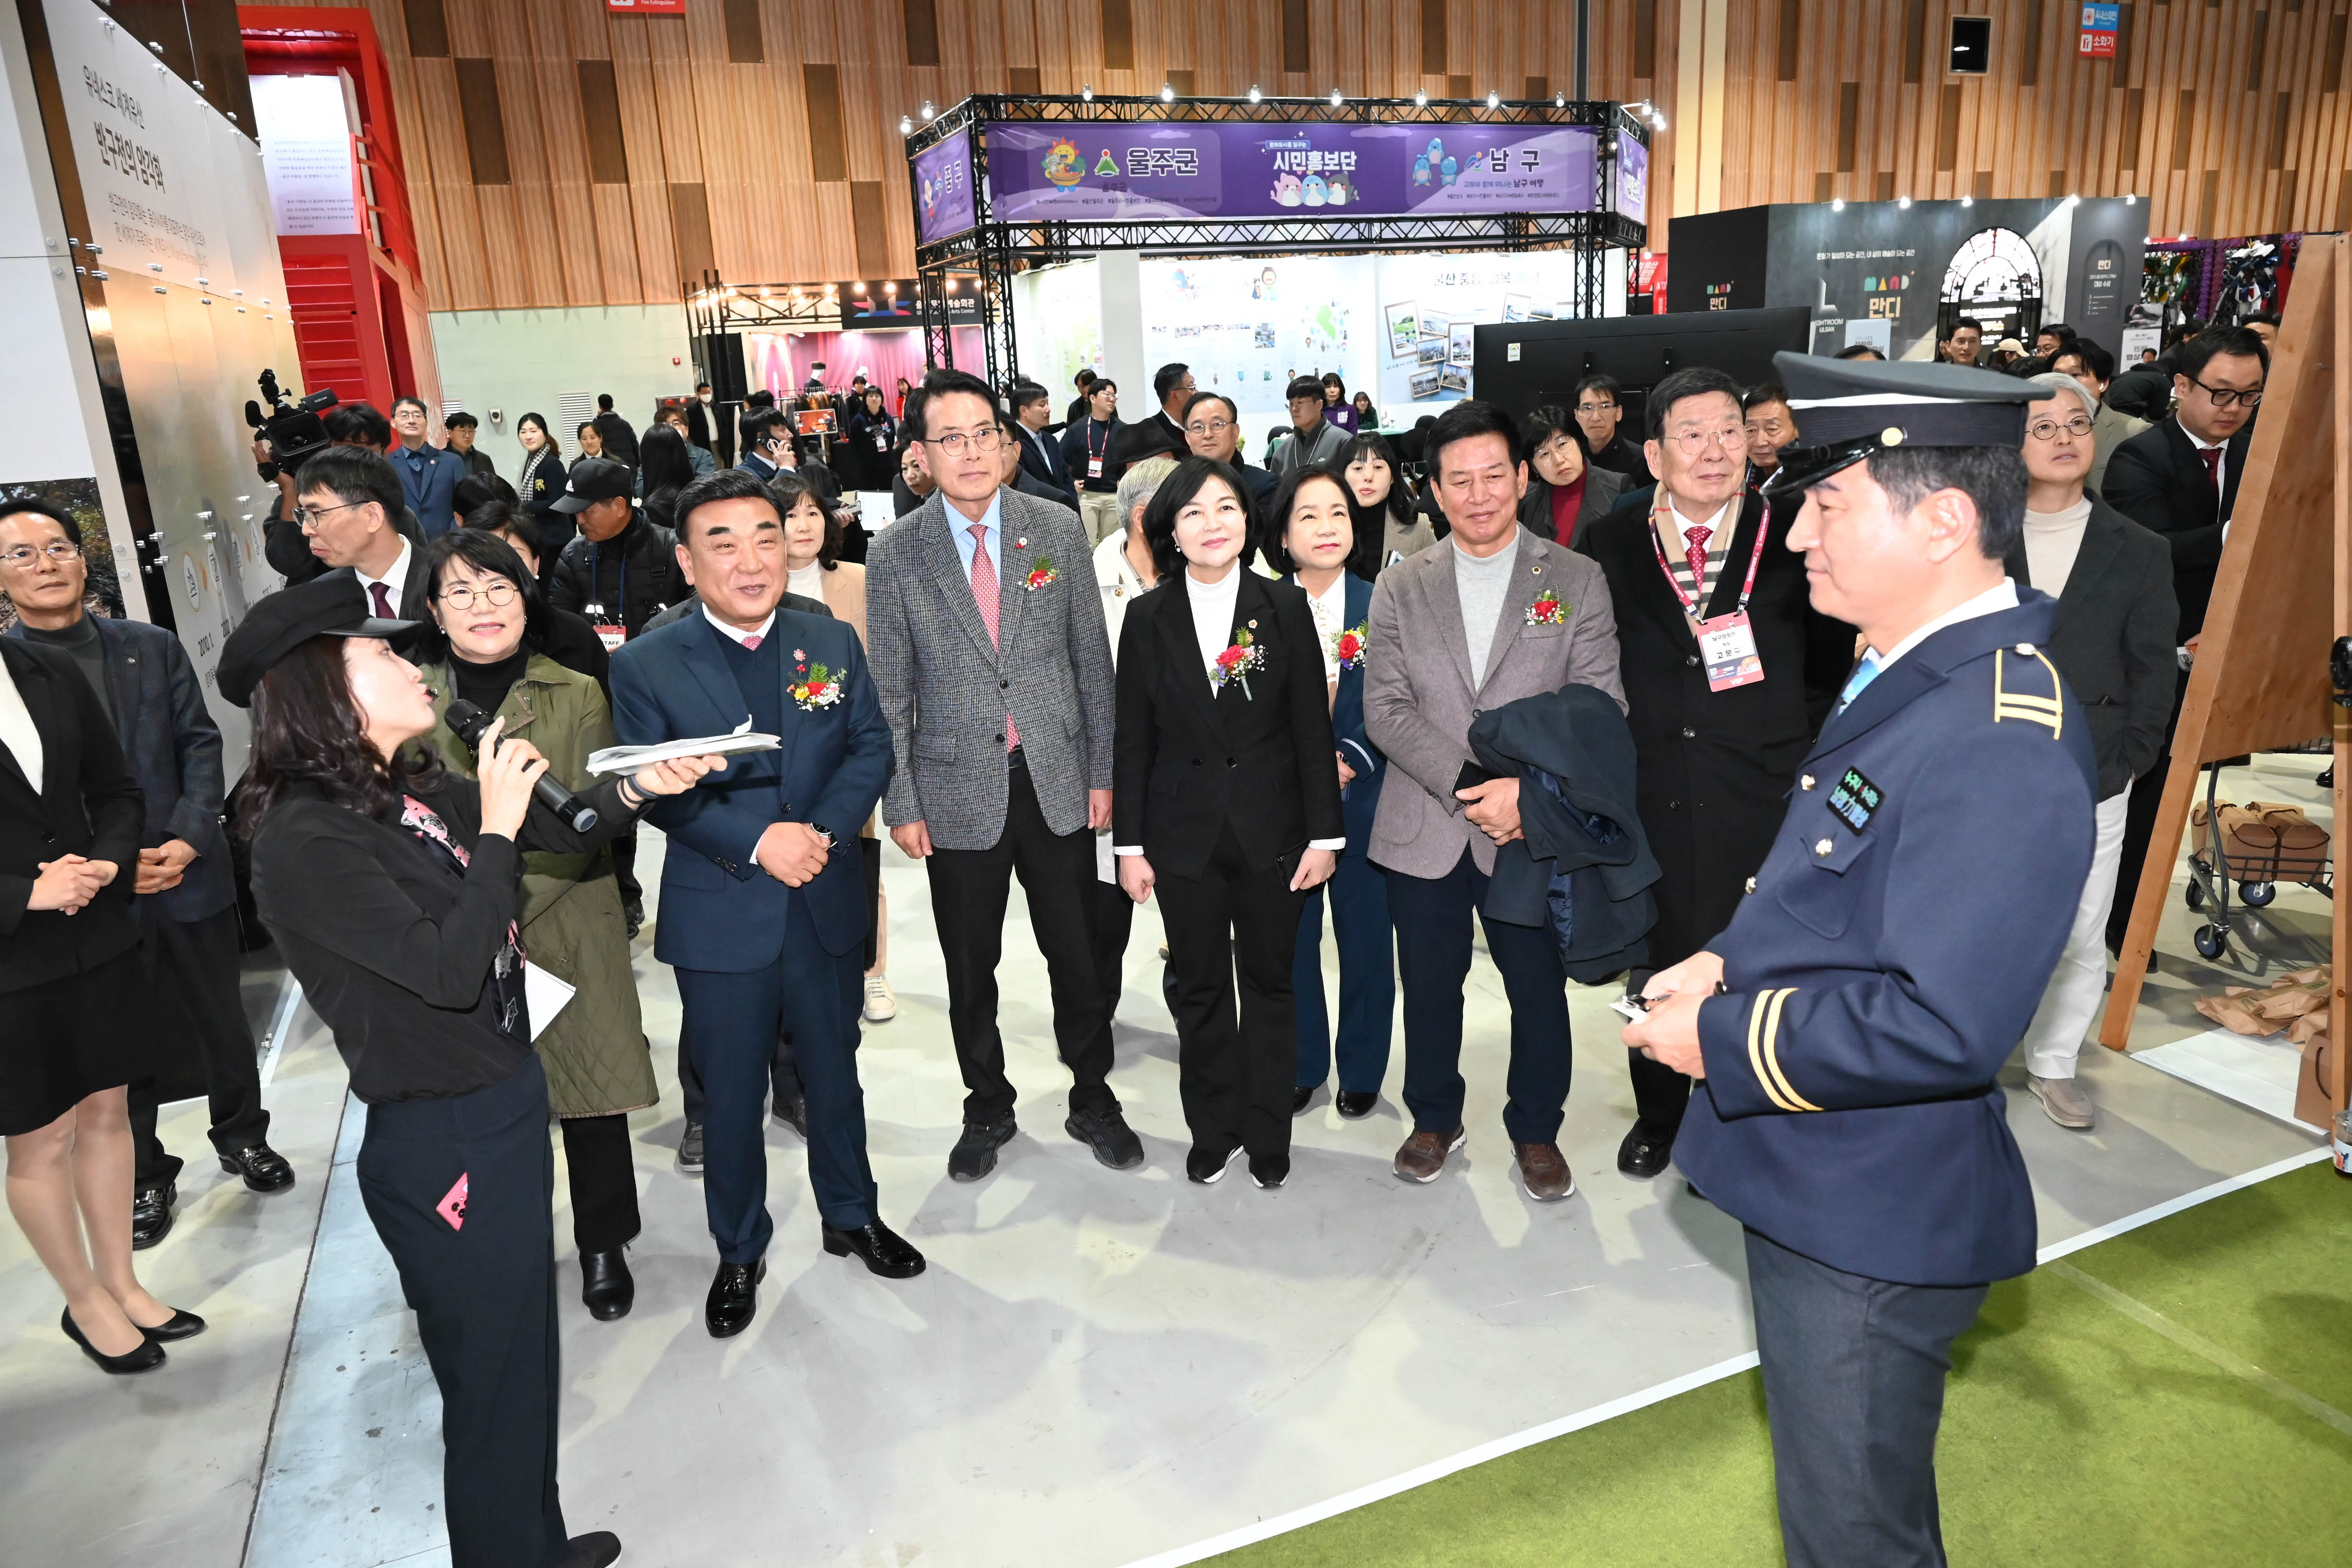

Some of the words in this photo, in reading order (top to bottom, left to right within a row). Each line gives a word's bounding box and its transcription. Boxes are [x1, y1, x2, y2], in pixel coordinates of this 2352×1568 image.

[2093, 35, 2114, 47] 소화기
[83, 65, 116, 109] 유네스코
[115, 87, 145, 130] 세계유산
[94, 121, 139, 181] 반구천의
[136, 145, 165, 194] 암각화
[1126, 148, 1198, 177] 울주군
[1273, 150, 1357, 172] 시민홍보단
[1513, 179, 1528, 188] 남구
[1529, 179, 1544, 188] 여행
[1817, 252, 1831, 260] 문화가
[1831, 251, 1845, 260] 일상이
[2098, 260, 2111, 270] 만디
[1709, 297, 1727, 310] 만디
[1868, 296, 1902, 319] 만디
